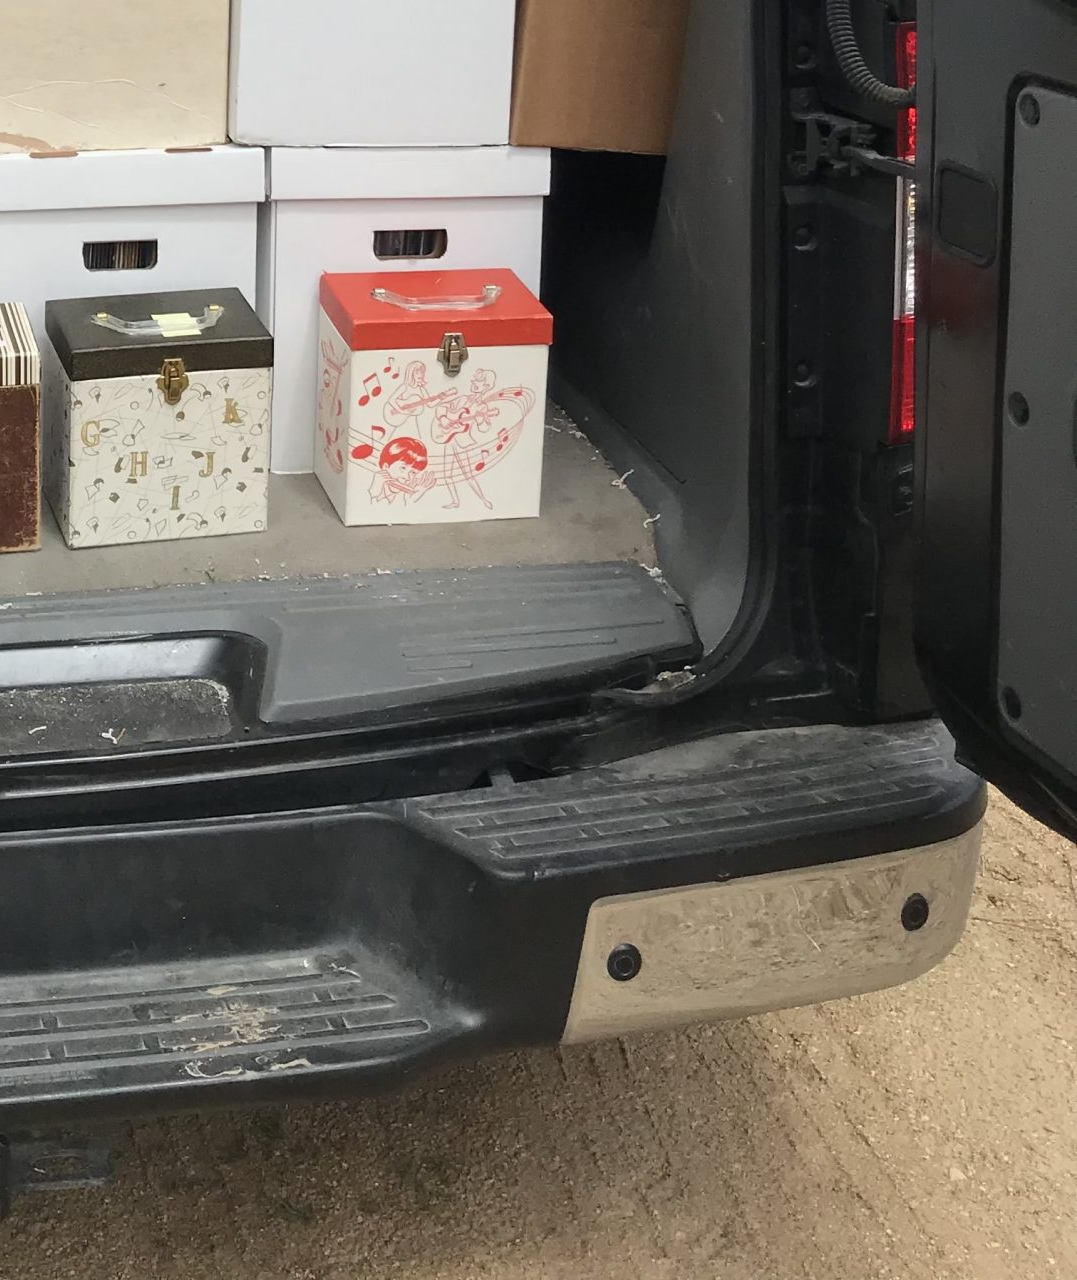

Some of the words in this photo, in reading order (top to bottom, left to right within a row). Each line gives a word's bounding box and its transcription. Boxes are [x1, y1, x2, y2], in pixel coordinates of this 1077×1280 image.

[223, 397, 242, 423] K
[80, 420, 101, 447] G
[129, 451, 148, 477] H
[199, 451, 215, 478] J
